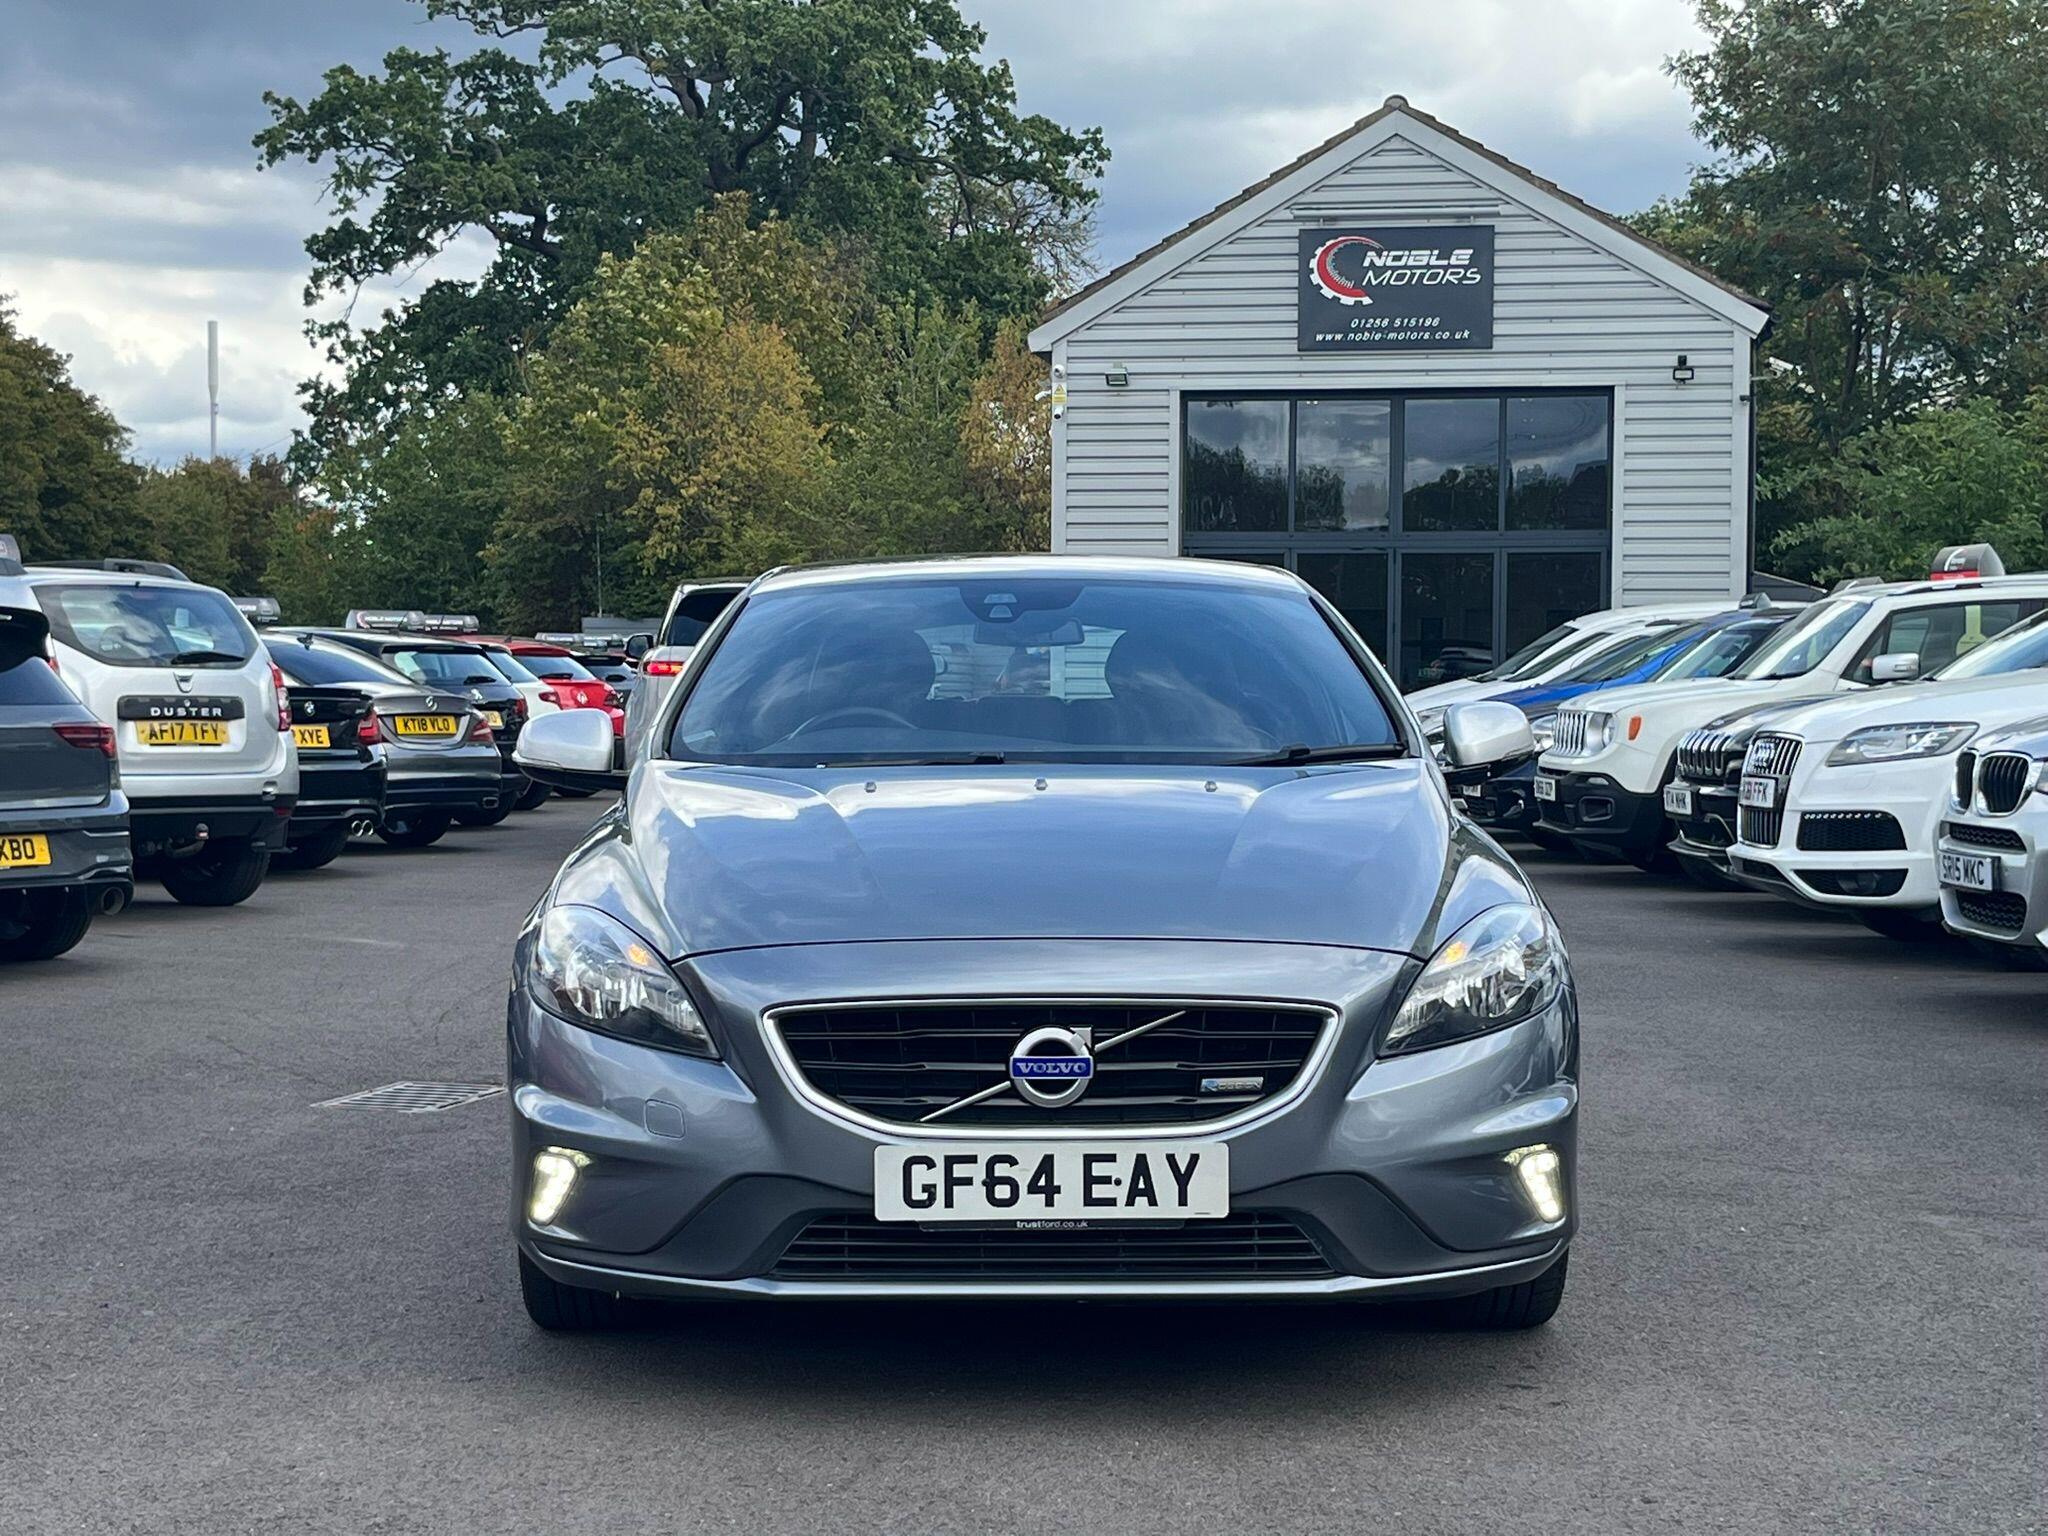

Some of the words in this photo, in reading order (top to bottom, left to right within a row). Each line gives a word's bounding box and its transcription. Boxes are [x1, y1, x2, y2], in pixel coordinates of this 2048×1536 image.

[1362, 248, 1474, 267] NOBLE
[1361, 268, 1482, 286] MOTORS
[149, 706, 223, 717] DUSTER
[148, 722, 186, 741] AF17
[190, 722, 219, 741] TFY
[402, 718, 428, 732] KT18
[298, 729, 324, 745] XYE
[1015, 1061, 1087, 1074] VOLVO
[902, 1153, 1062, 1210] GF64
[1082, 1152, 1201, 1208] EAY
[1016, 1220, 1089, 1229] trustford.co.uk
